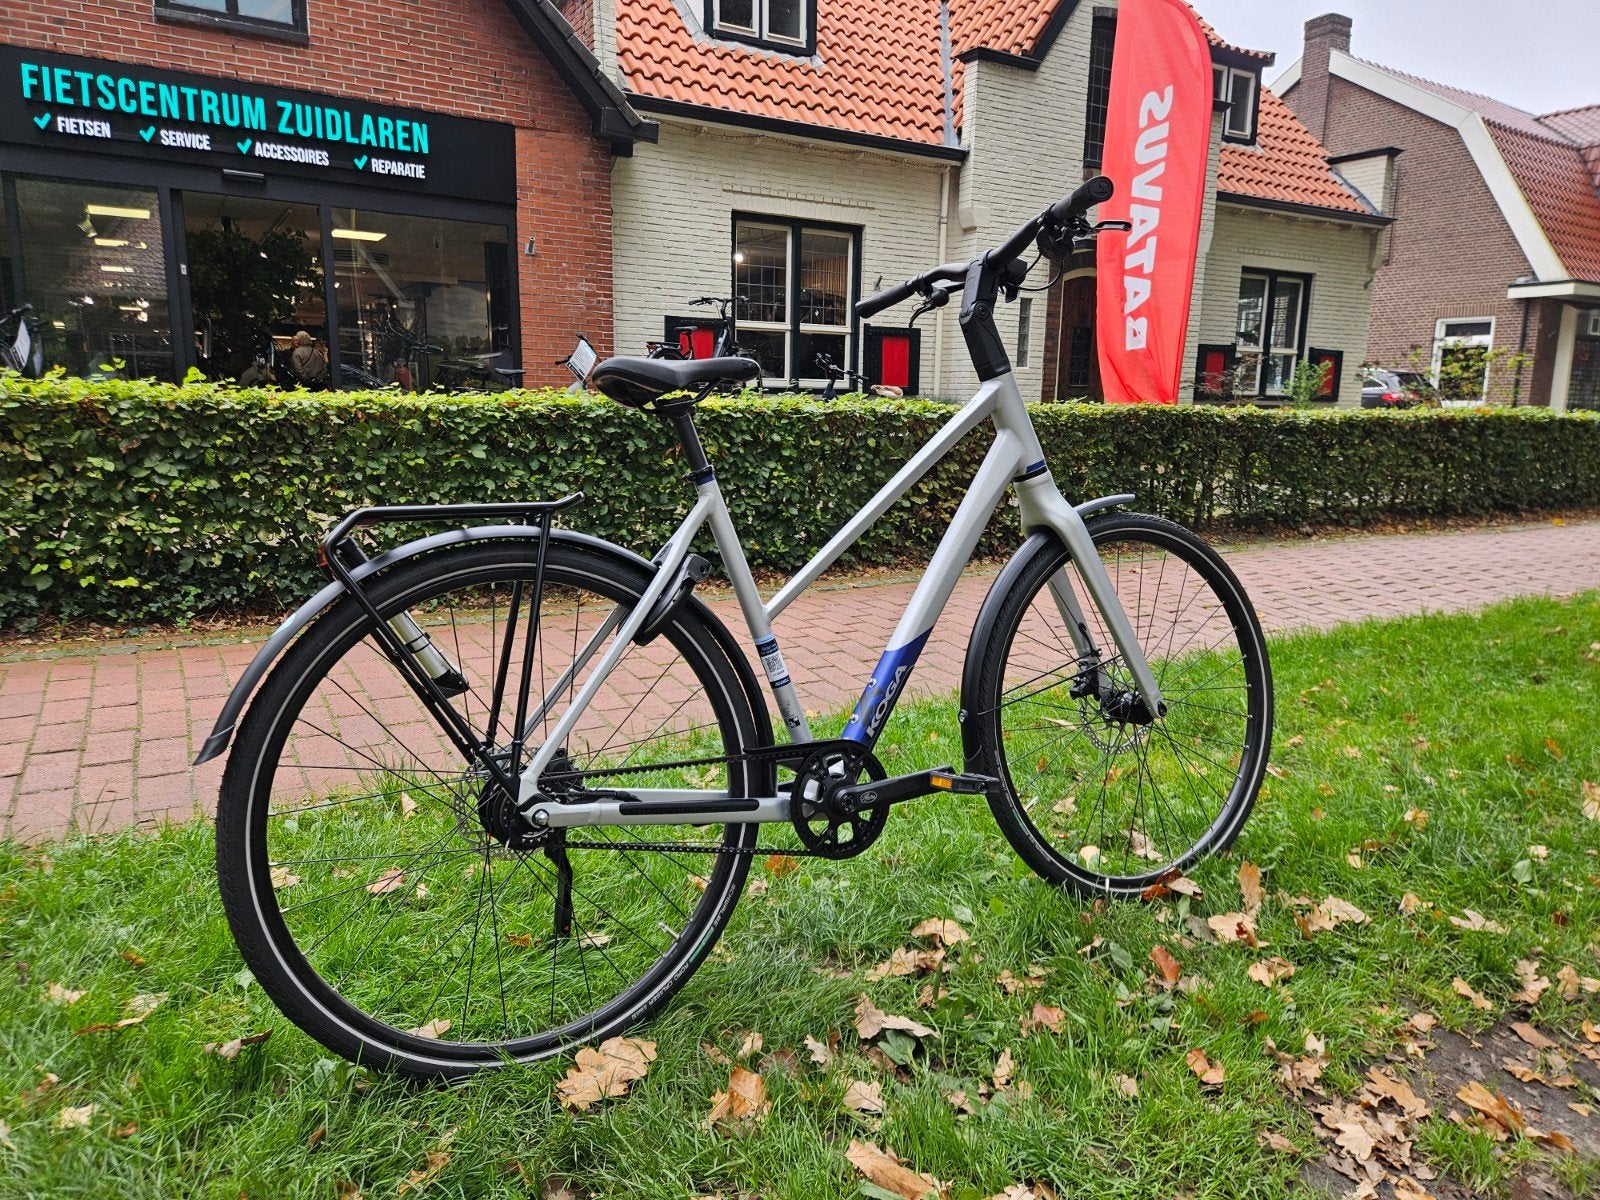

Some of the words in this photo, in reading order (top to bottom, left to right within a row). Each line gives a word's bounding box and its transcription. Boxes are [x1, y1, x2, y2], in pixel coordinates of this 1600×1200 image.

[21, 63, 267, 131] FIETSCENTRUM
[277, 101, 429, 154] ZUIDLAREN
[57, 117, 111, 139] FIETSEN
[160, 130, 211, 151] SERVICE
[255, 142, 329, 167] ACCESSOIRES
[371, 158, 425, 179] REPARATIE
[866, 665, 907, 738] KOGA
